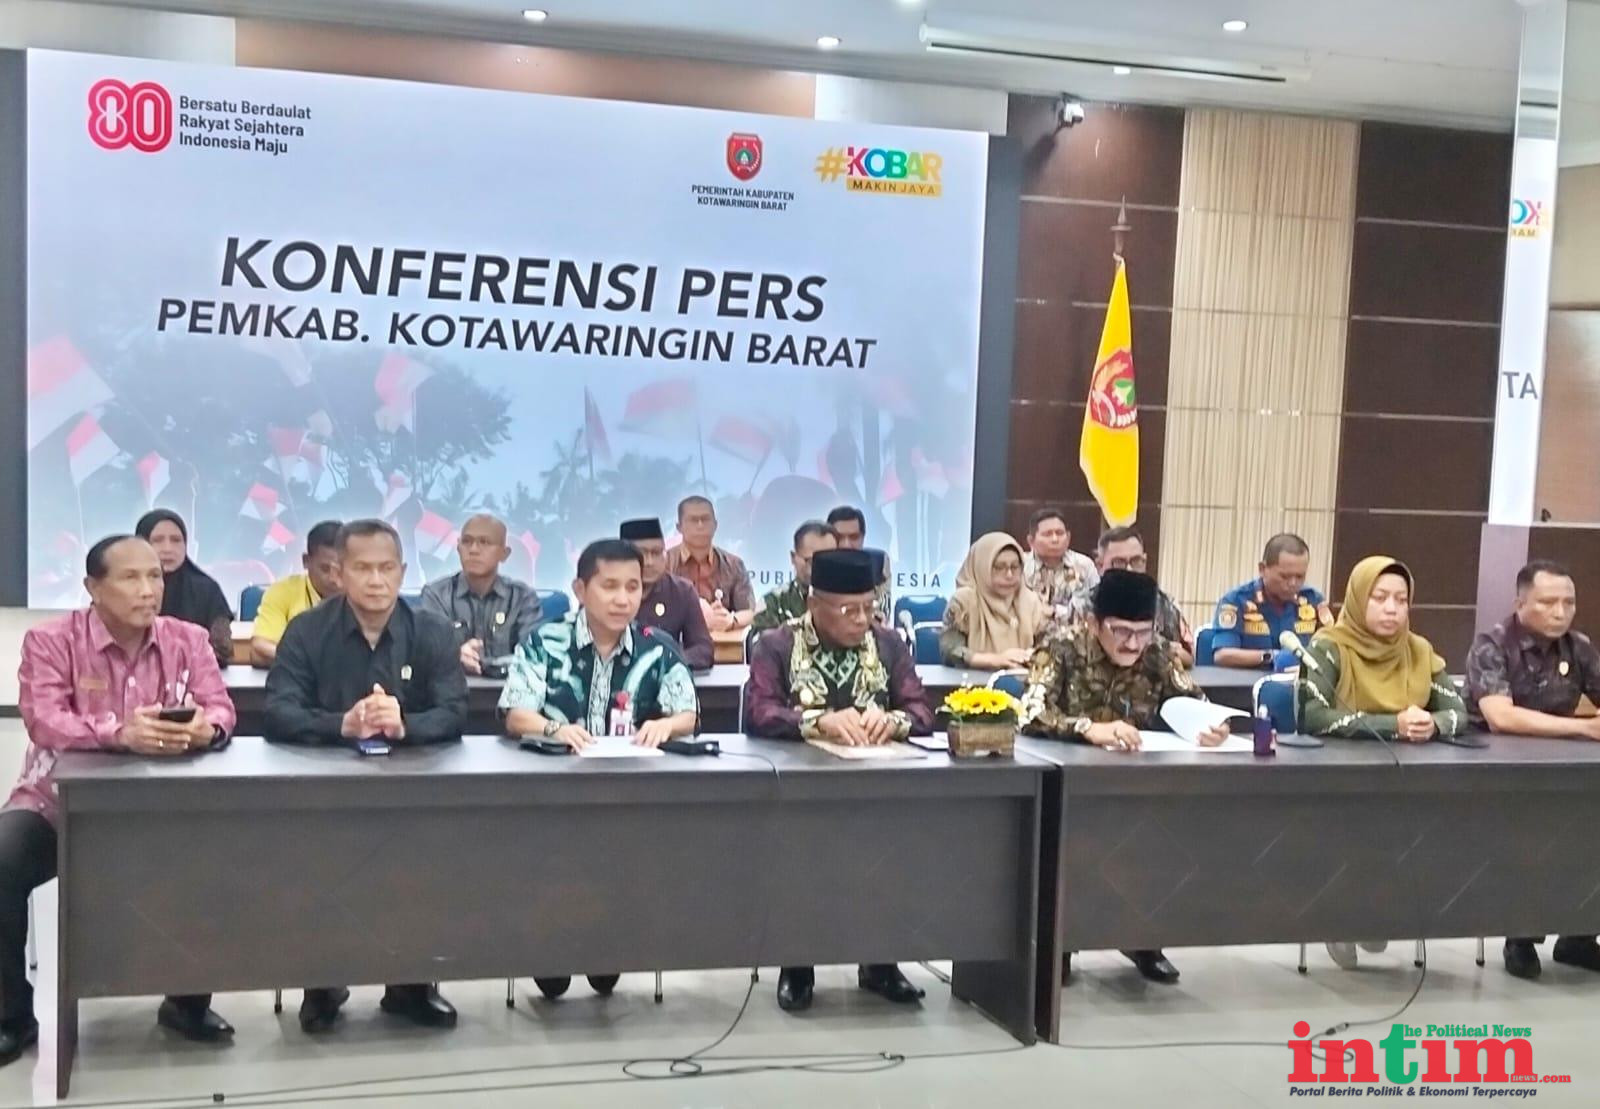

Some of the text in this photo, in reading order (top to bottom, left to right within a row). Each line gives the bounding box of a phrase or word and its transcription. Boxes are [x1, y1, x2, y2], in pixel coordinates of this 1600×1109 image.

[179, 95, 312, 120] Bersatu Berdaulat
[179, 113, 304, 138] Rakyat Sejahtera
[179, 132, 289, 156] Indonesia Maju
[691, 184, 794, 201] PEMERINTAH KABUPATEN
[852, 180, 936, 196] MAKIN JAYA
[697, 197, 788, 212] KOTAWARINGIN BARAT
[221, 237, 828, 323] KONFERENSI PERS
[157, 298, 878, 370] PEMKAB. KOTAWARINGIN BARAT
